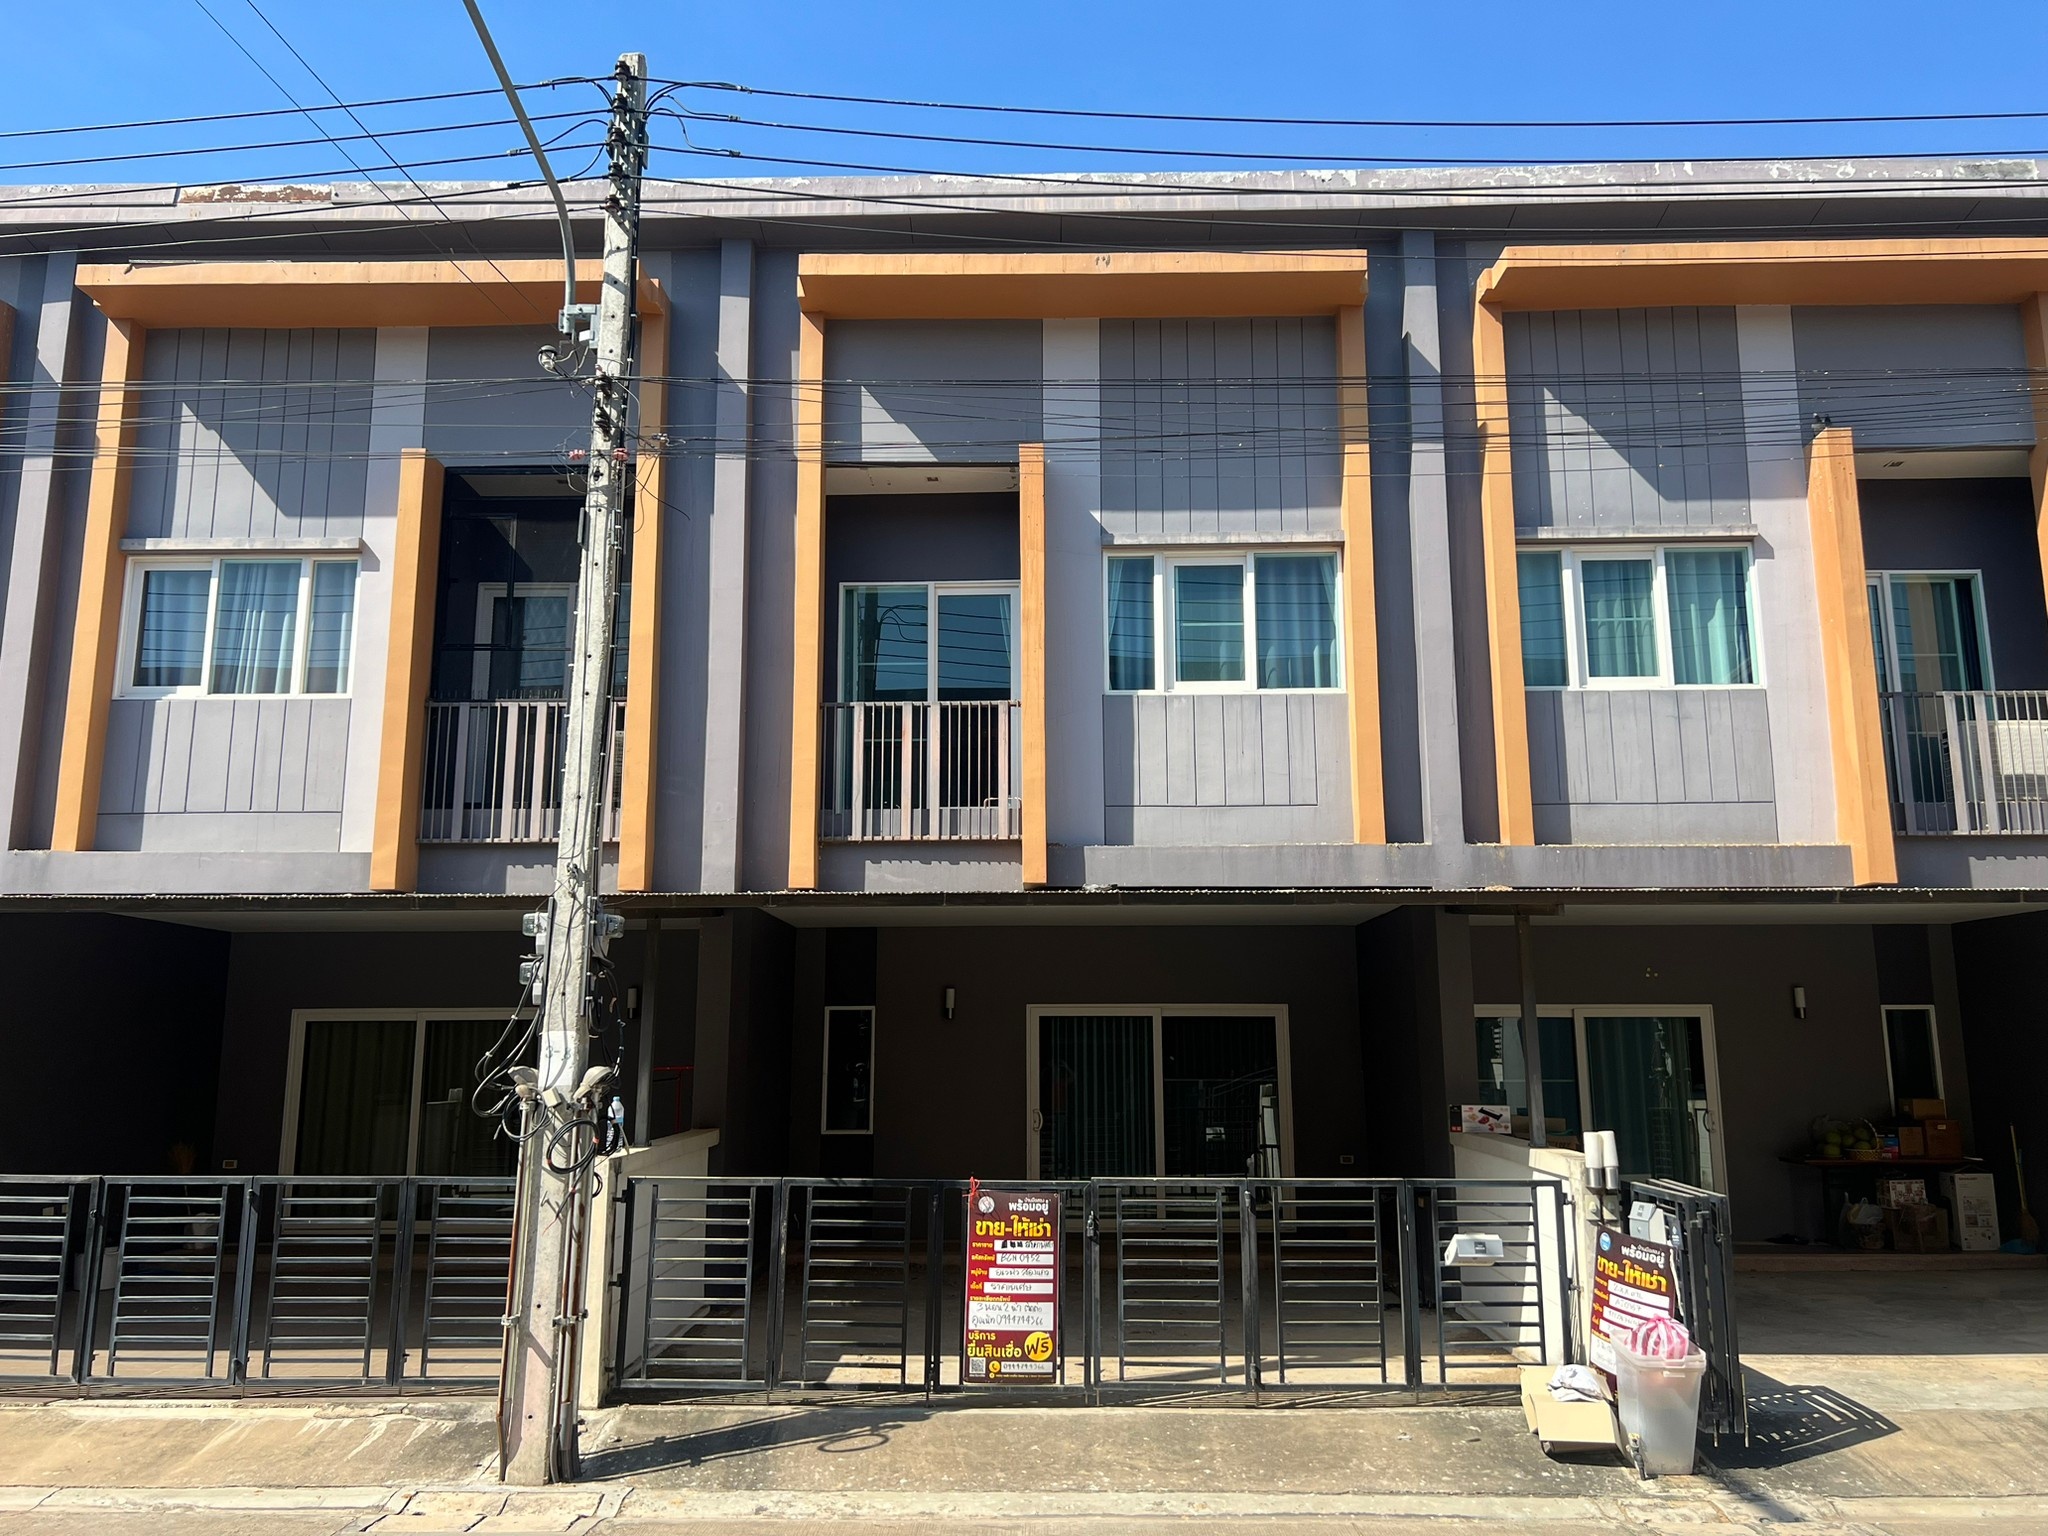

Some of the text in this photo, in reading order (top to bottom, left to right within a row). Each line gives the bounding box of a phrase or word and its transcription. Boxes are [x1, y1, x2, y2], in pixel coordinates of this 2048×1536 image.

[1009, 1199, 1049, 1215] พร้อมอยู่
[975, 1214, 1052, 1237] ขาย-ให้เช่า
[1621, 1244, 1665, 1269] พร้อมอยู่
[1597, 1255, 1667, 1292] ขาย-ให้เช่า
[968, 1330, 996, 1340] บริการ
[967, 1336, 1050, 1357] ยื่นสินเชื่อ ฟรี
